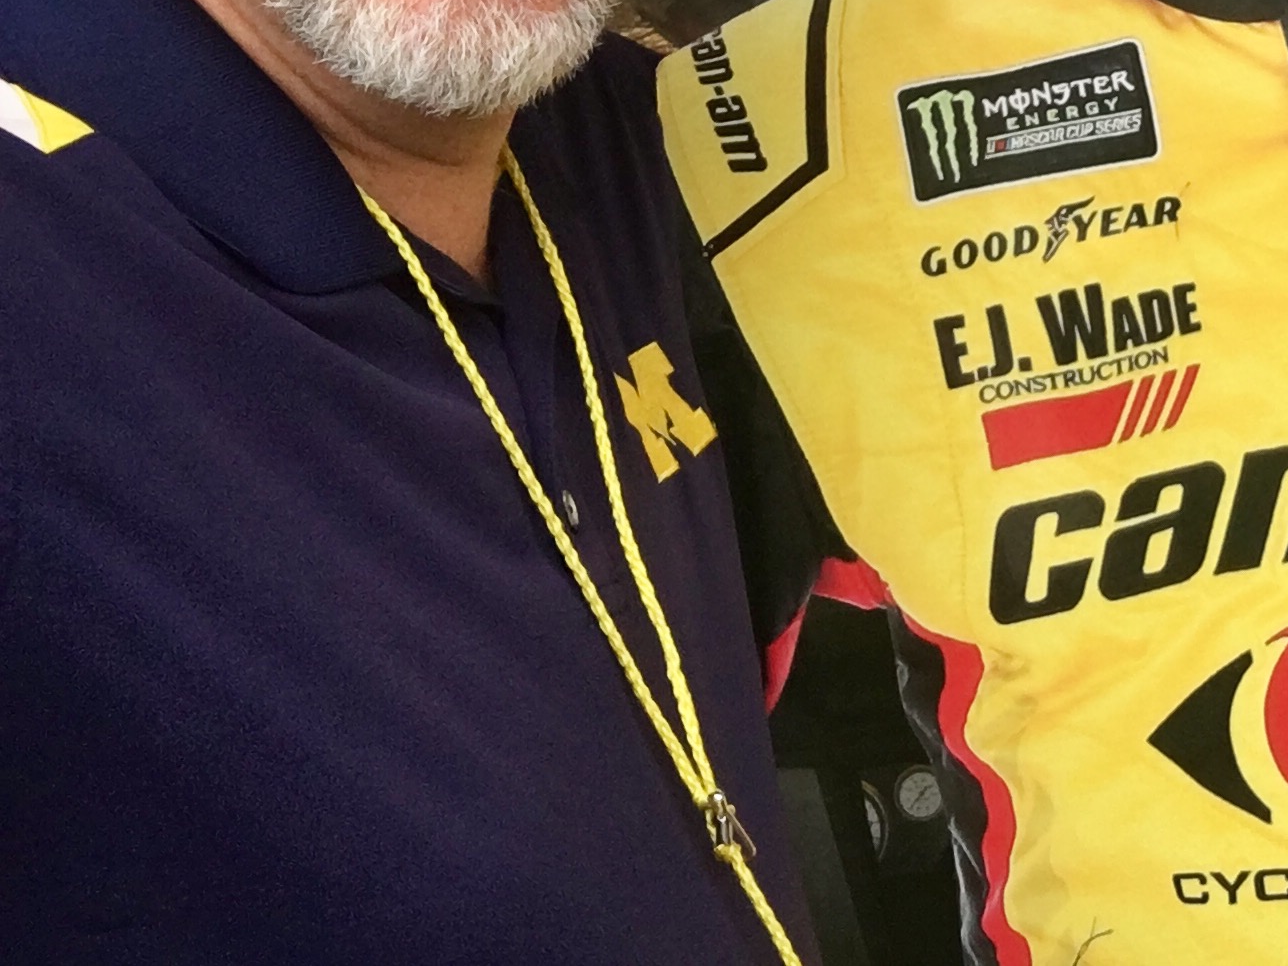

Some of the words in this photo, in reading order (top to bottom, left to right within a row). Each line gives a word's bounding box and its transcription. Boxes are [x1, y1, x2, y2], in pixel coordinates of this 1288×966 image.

[1006, 96, 1119, 131] ENERGY
[978, 345, 1169, 404] CONSTRUCTION
[613, 341, 718, 484] M
